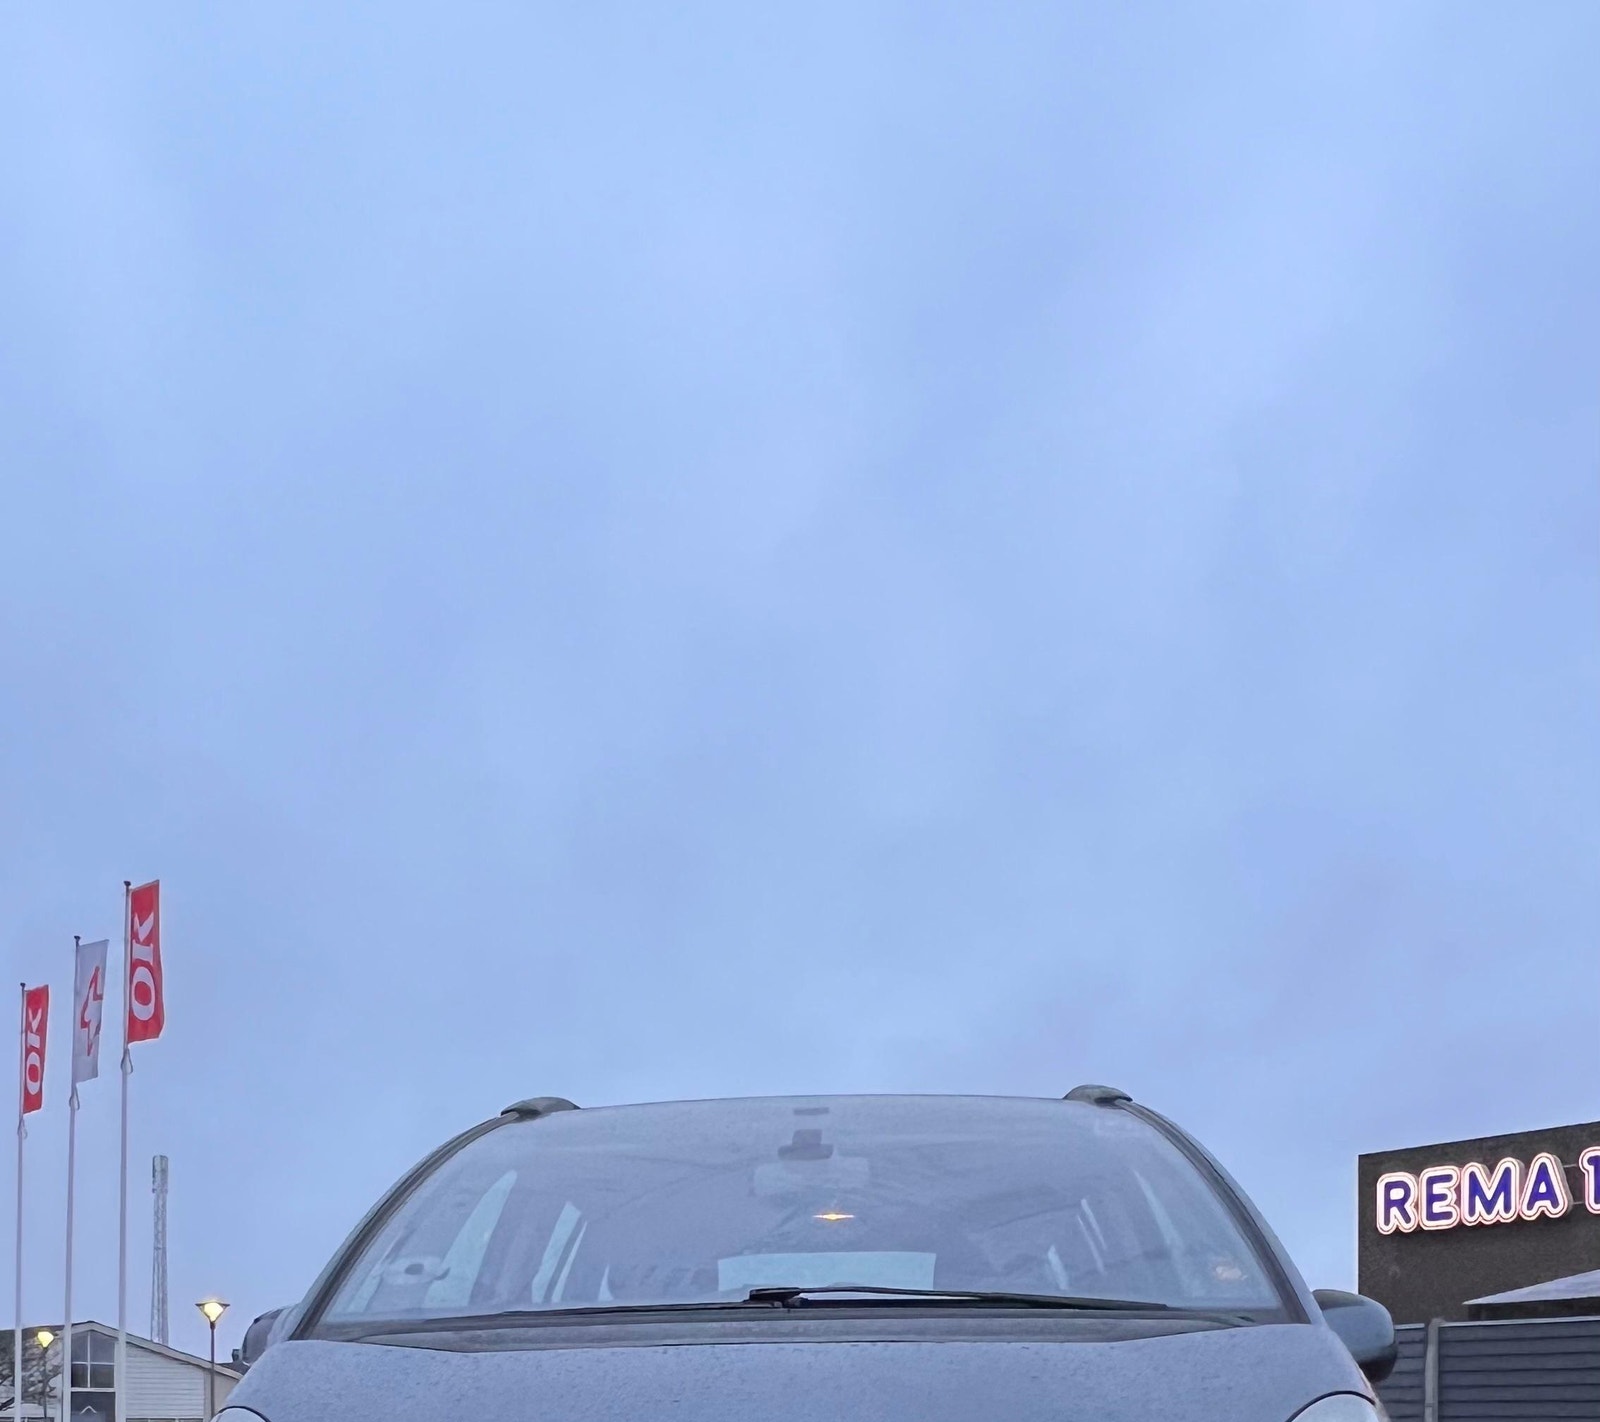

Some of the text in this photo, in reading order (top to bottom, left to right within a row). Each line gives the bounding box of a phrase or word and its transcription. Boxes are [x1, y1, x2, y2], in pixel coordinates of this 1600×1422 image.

[132, 912, 155, 1021] OK
[26, 1008, 42, 1095] OK
[1377, 1152, 1568, 1235] REMA
